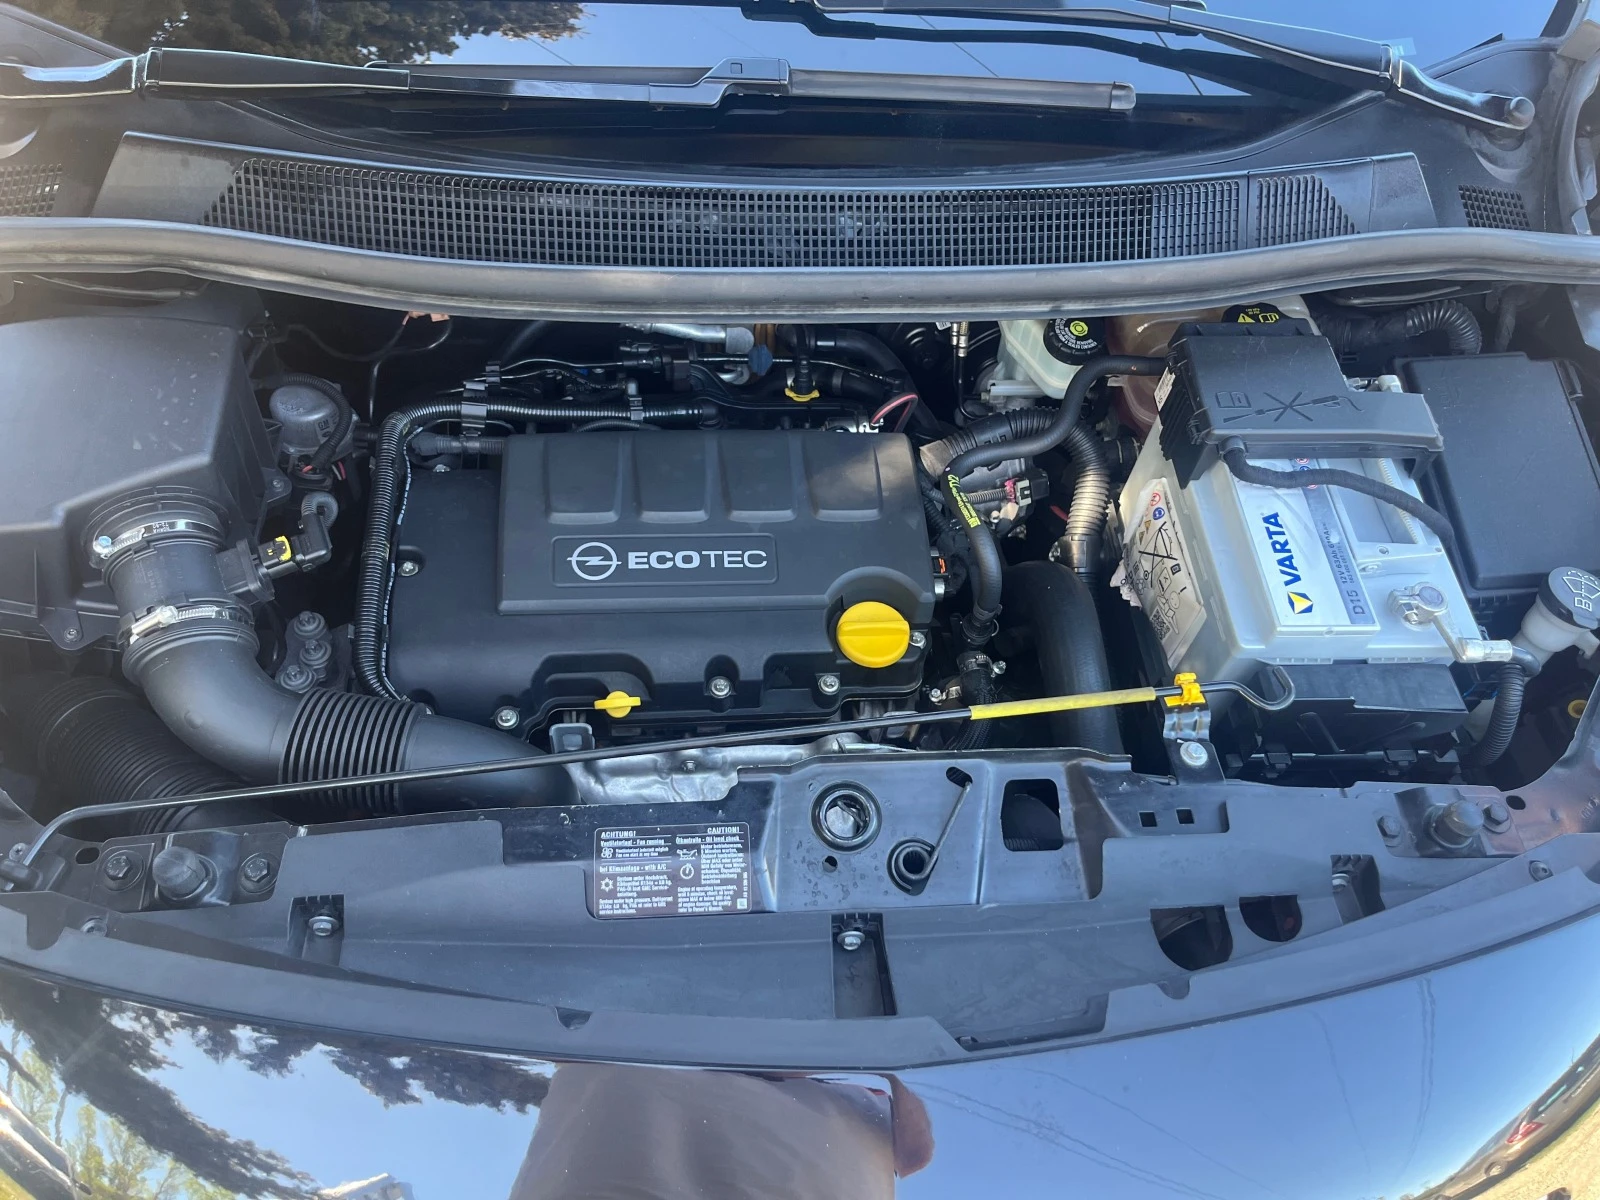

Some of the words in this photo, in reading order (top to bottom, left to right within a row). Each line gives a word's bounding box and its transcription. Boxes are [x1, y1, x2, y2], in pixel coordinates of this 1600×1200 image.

[1262, 512, 1301, 587] VARTA
[627, 550, 767, 569] ECOTEC
[1332, 550, 1342, 569] 63Ah
[1338, 570, 1347, 584] 12V
[1347, 590, 1365, 615] D15
[601, 830, 636, 838] ACHTUNG!
[707, 826, 740, 834] CAUTION!
